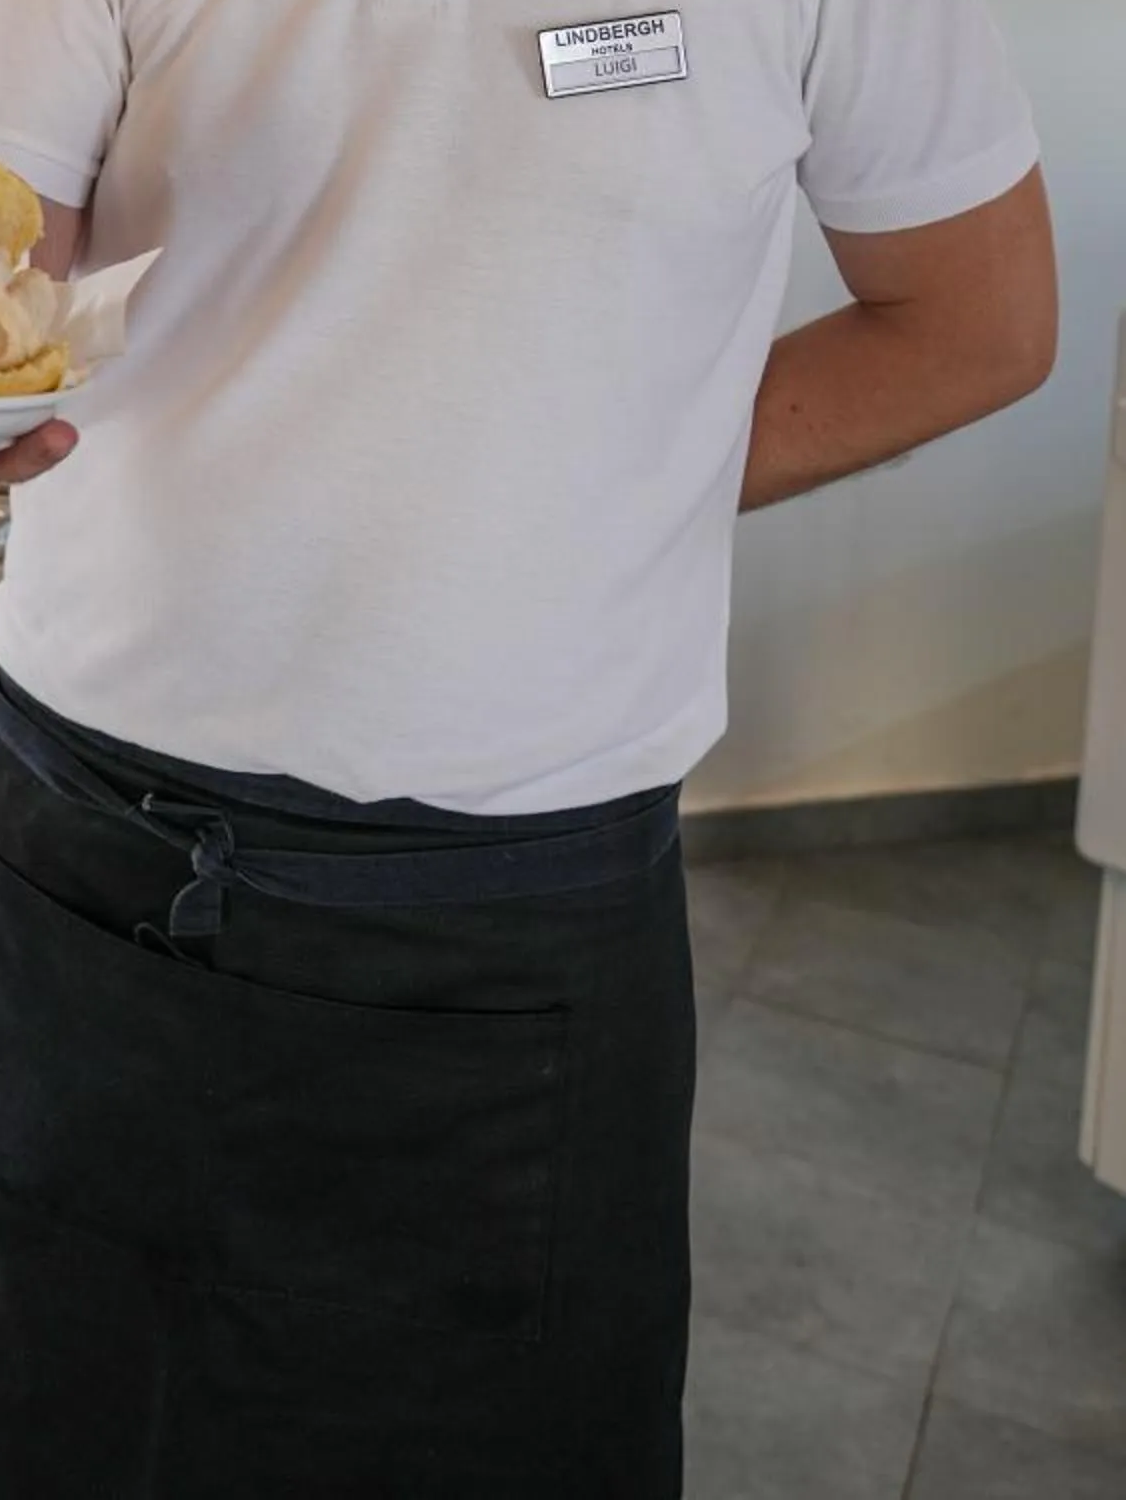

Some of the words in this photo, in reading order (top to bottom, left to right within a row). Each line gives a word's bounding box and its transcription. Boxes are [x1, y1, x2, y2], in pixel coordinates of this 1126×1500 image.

[555, 18, 664, 46] LINDBERGH
[591, 42, 633, 56] HOTELS
[594, 58, 637, 77] LUIGI
